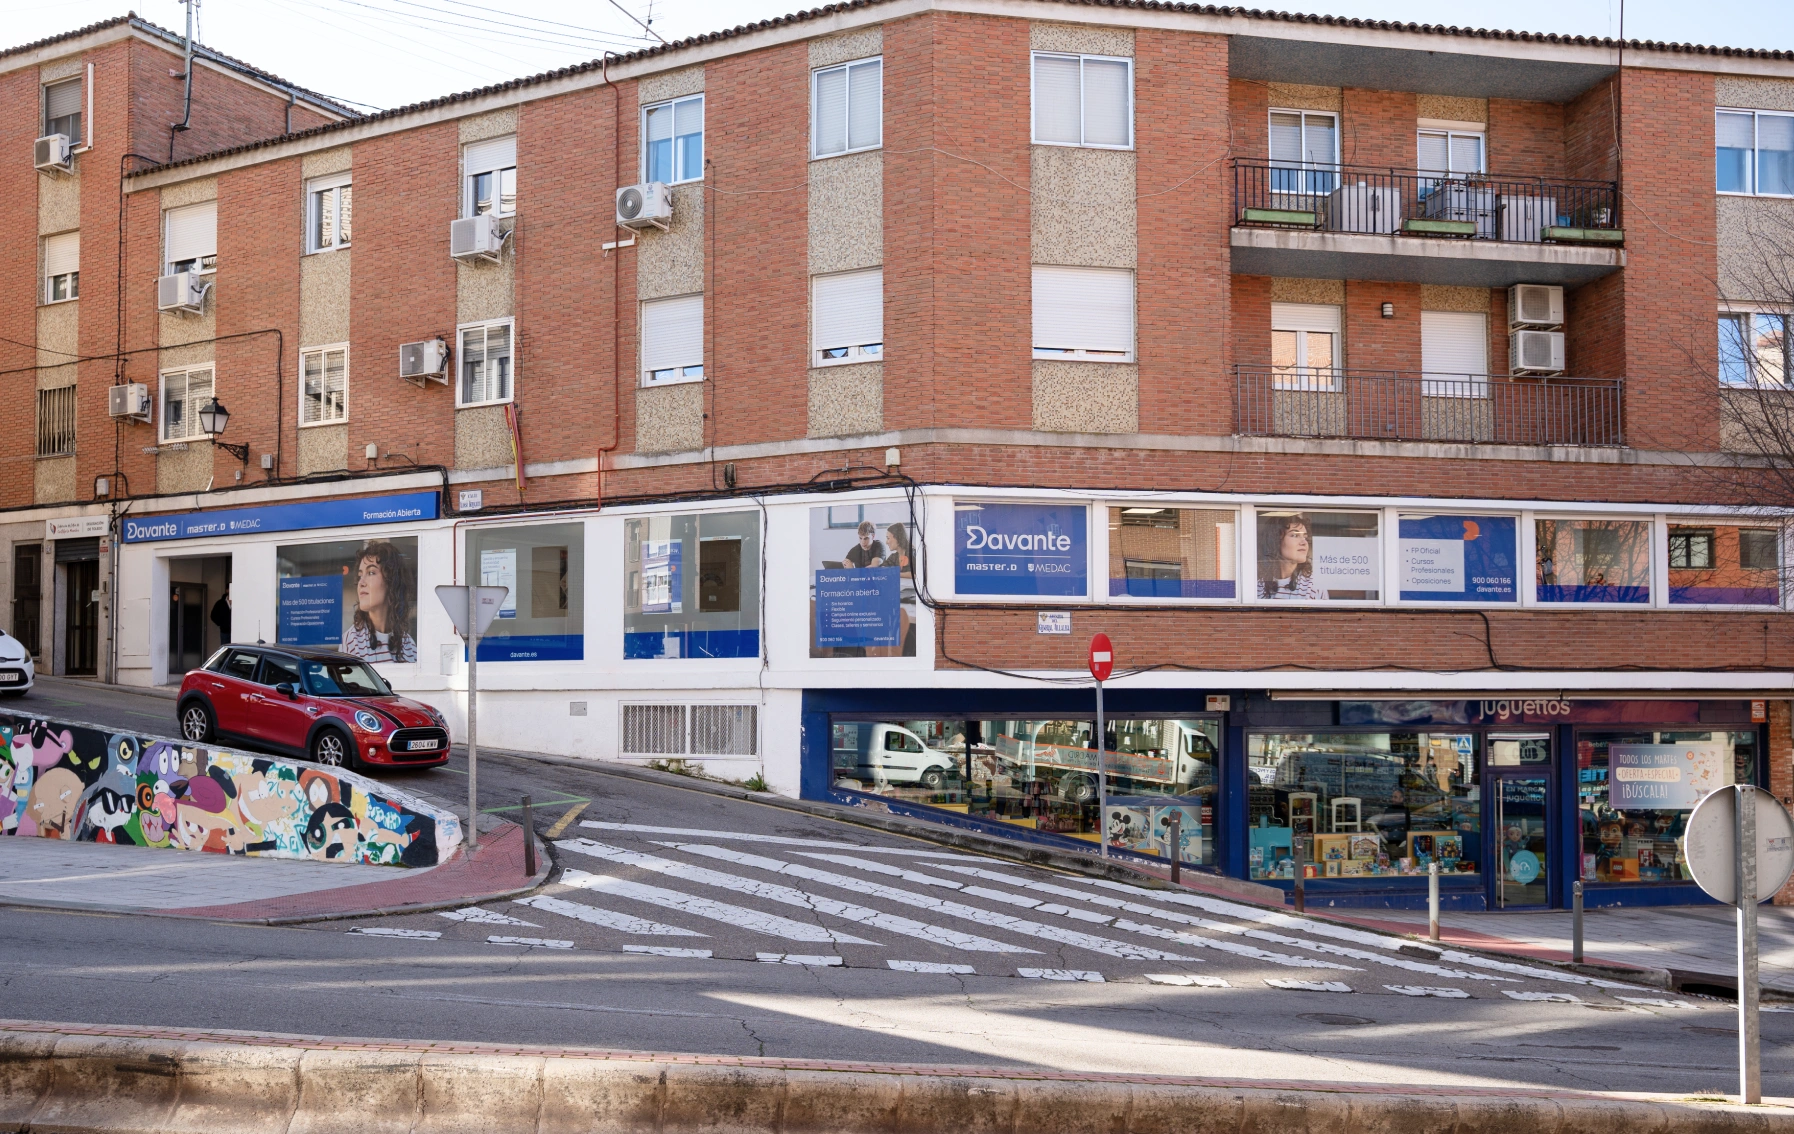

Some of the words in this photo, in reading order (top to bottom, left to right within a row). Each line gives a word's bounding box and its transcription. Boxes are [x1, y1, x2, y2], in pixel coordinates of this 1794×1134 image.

[363, 510, 396, 520] Formación
[397, 508, 421, 517] Abierta
[128, 522, 176, 539] Davante
[235, 518, 260, 529] MEDAC
[966, 525, 1071, 551] Davante
[1320, 555, 1337, 564] Más
[1339, 556, 1350, 564] de
[1352, 556, 1368, 564] 500
[1035, 563, 1071, 573] MEDAC
[1320, 566, 1370, 575] titulaciones
[1480, 700, 1570, 720] juguettos
[1513, 748, 1538, 760] CLUB
[1619, 754, 1638, 765] TODOS
[1641, 754, 1652, 764] LOS
[1654, 754, 1677, 764] MARTES
[1621, 770, 1644, 779] OFERTA
[1647, 770, 1676, 780] ESPECIAL
[1622, 782, 1668, 799] ¡BÚSCALA!
